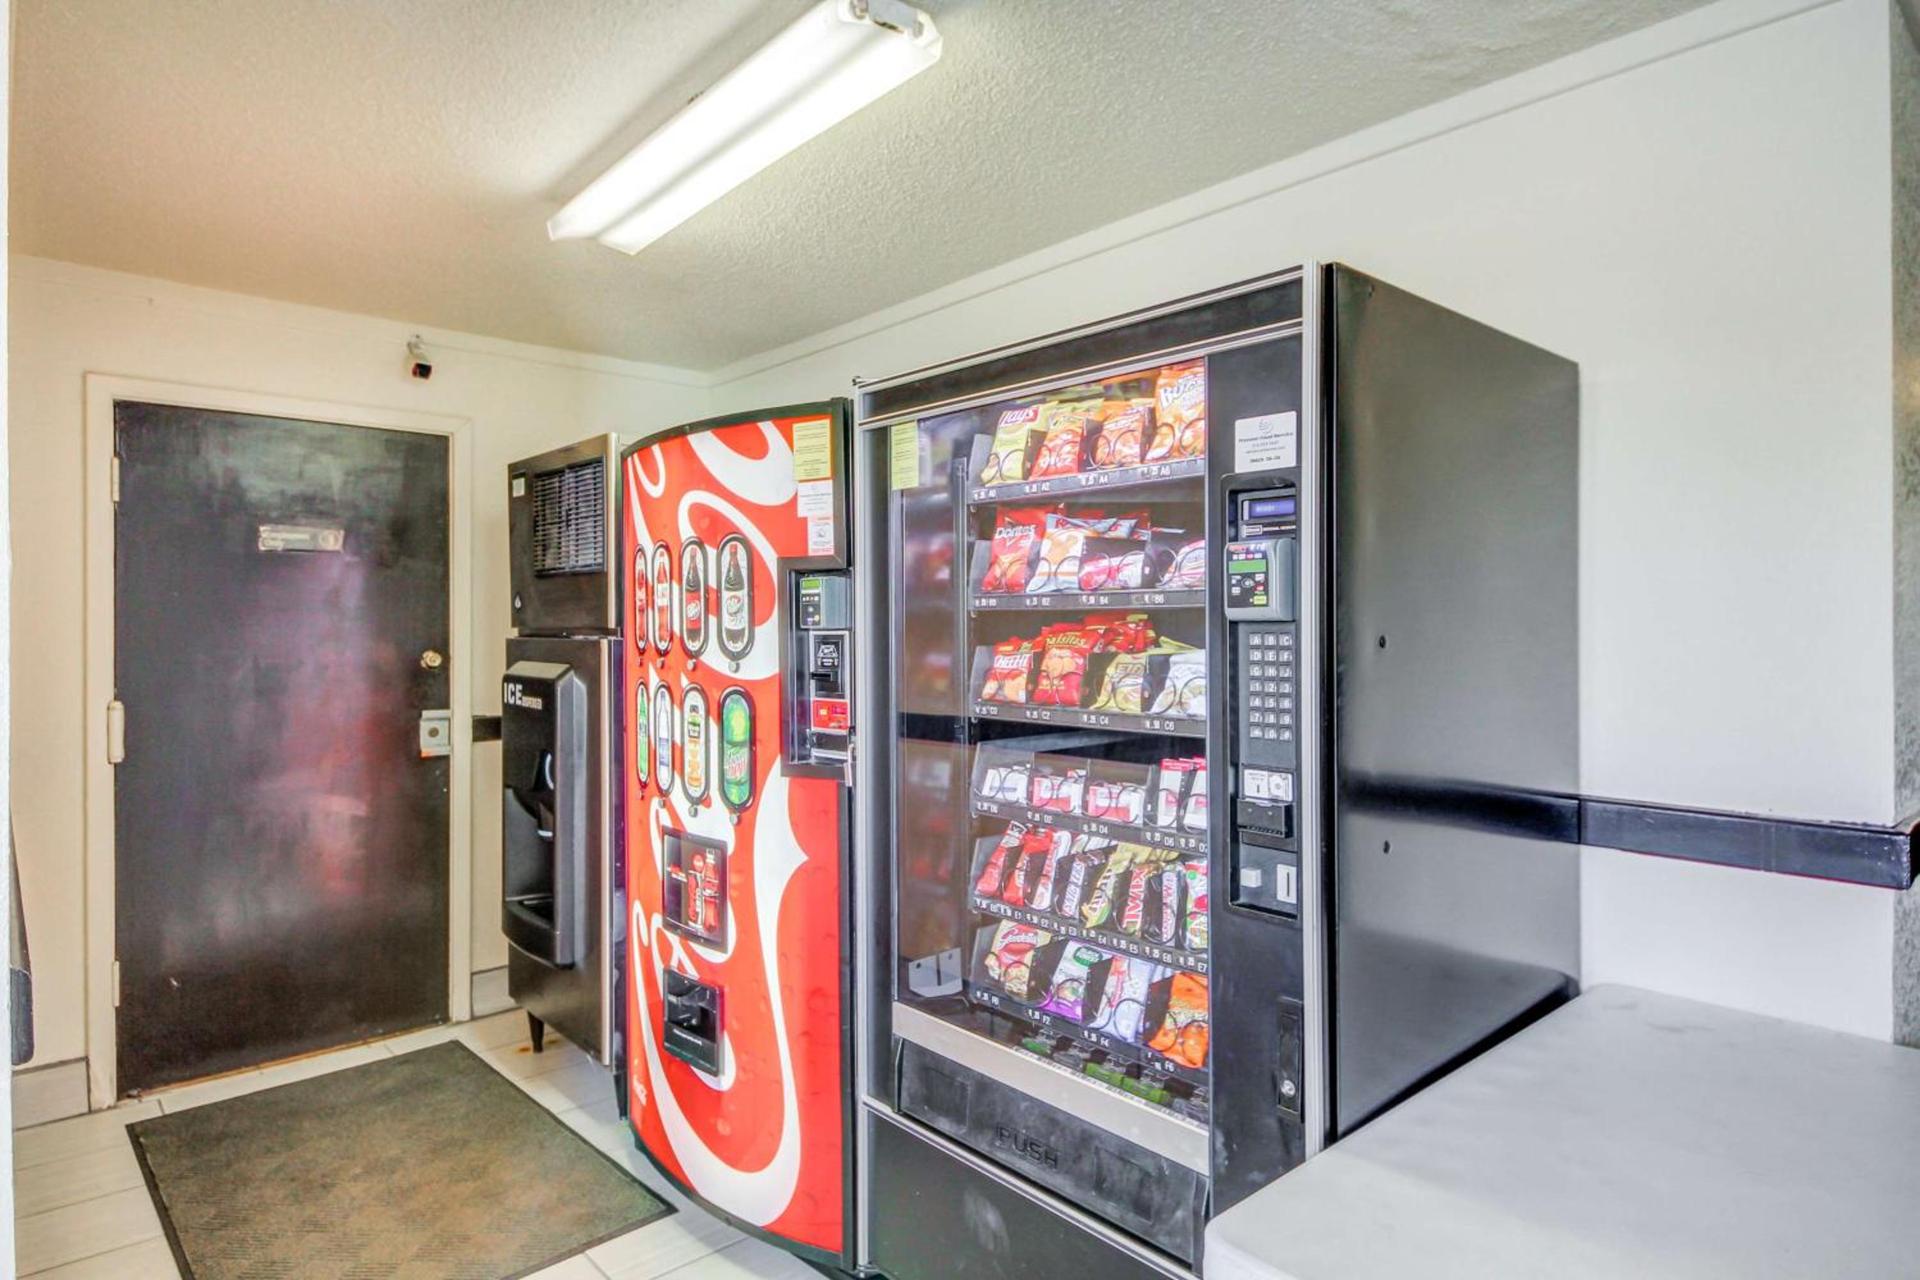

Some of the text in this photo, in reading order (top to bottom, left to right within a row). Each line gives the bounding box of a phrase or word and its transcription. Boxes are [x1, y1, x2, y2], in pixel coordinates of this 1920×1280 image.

[503, 682, 523, 704] ICE
[1099, 715, 1109, 725] C4
[1164, 721, 1175, 730] C6
[1099, 824, 1108, 834] D4
[1121, 864, 1149, 931] TWIX
[1098, 935, 1107, 944] E4
[1129, 943, 1139, 953] E5
[1197, 962, 1207, 972] E7
[1164, 1060, 1175, 1072] F6
[995, 1124, 1058, 1170] PUSH
